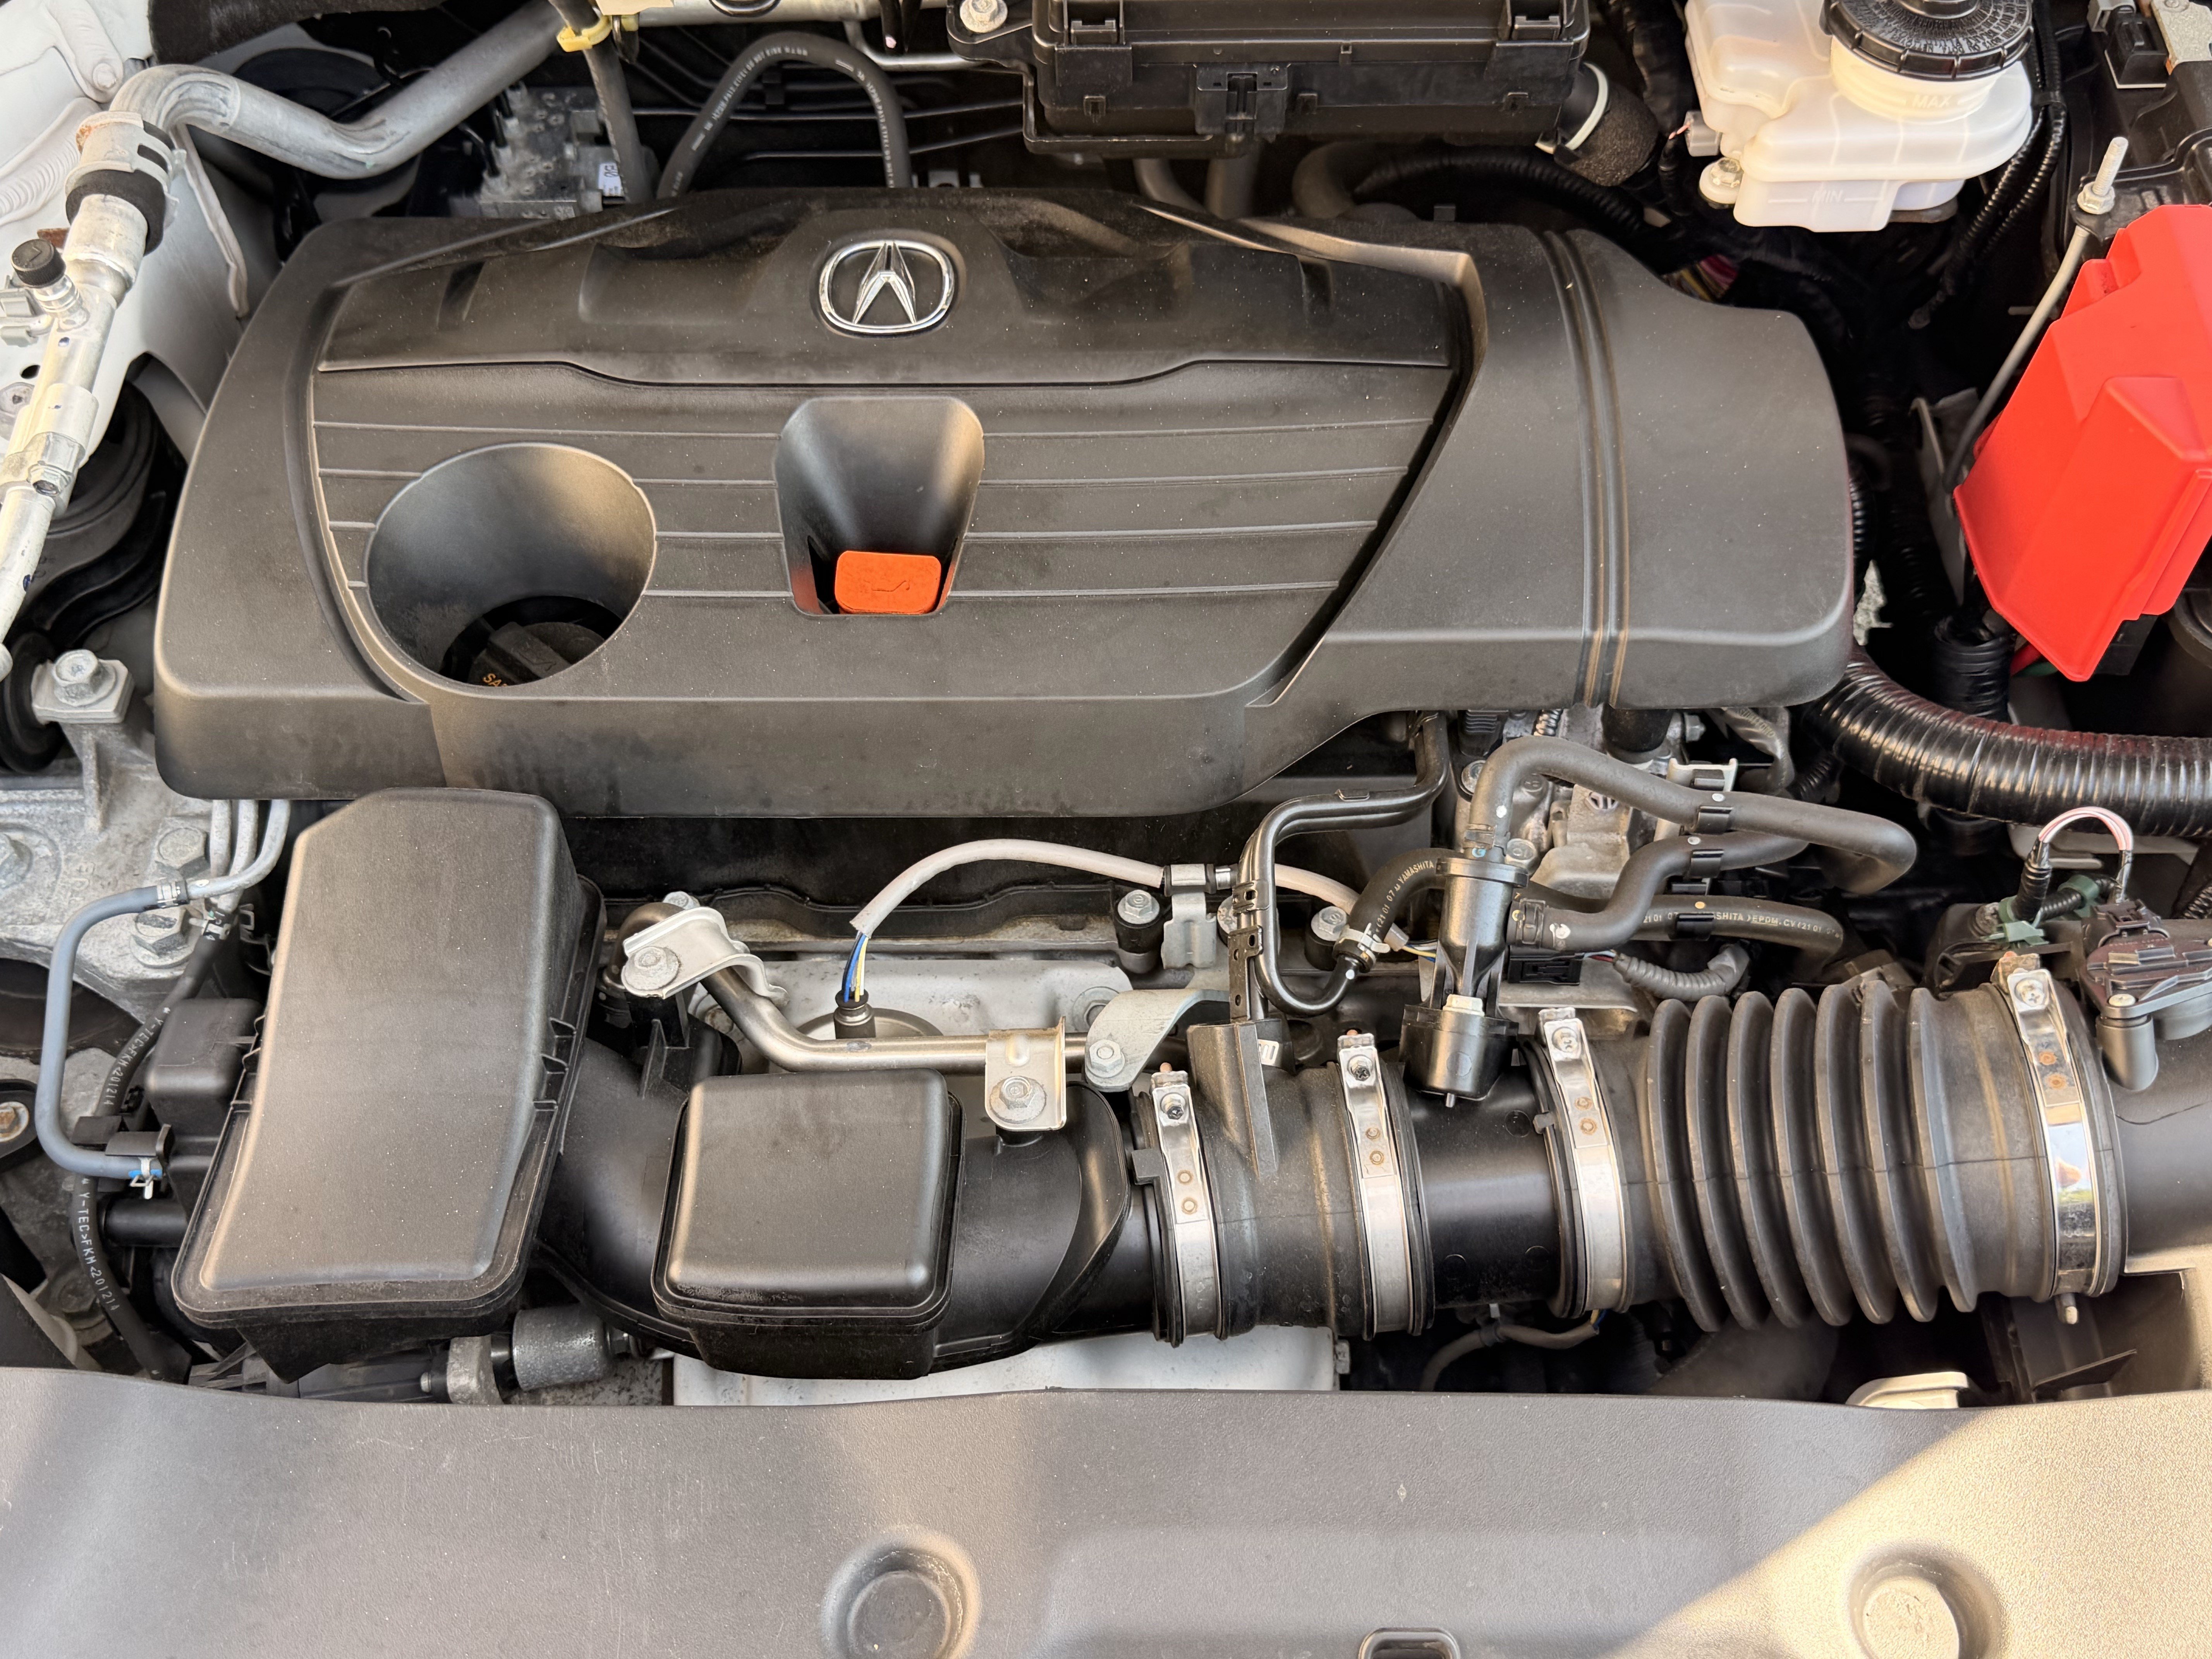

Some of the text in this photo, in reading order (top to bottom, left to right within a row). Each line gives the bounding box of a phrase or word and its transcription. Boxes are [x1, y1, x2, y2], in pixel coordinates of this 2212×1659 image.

[1912, 94, 1952, 109] MAX
[1812, 189, 1843, 203] MIN
[483, 673, 508, 687] SA
[1382, 904, 1390, 914] 01
[1386, 890, 1395, 902] 07
[1398, 860, 1434, 884] YAMASHITA
